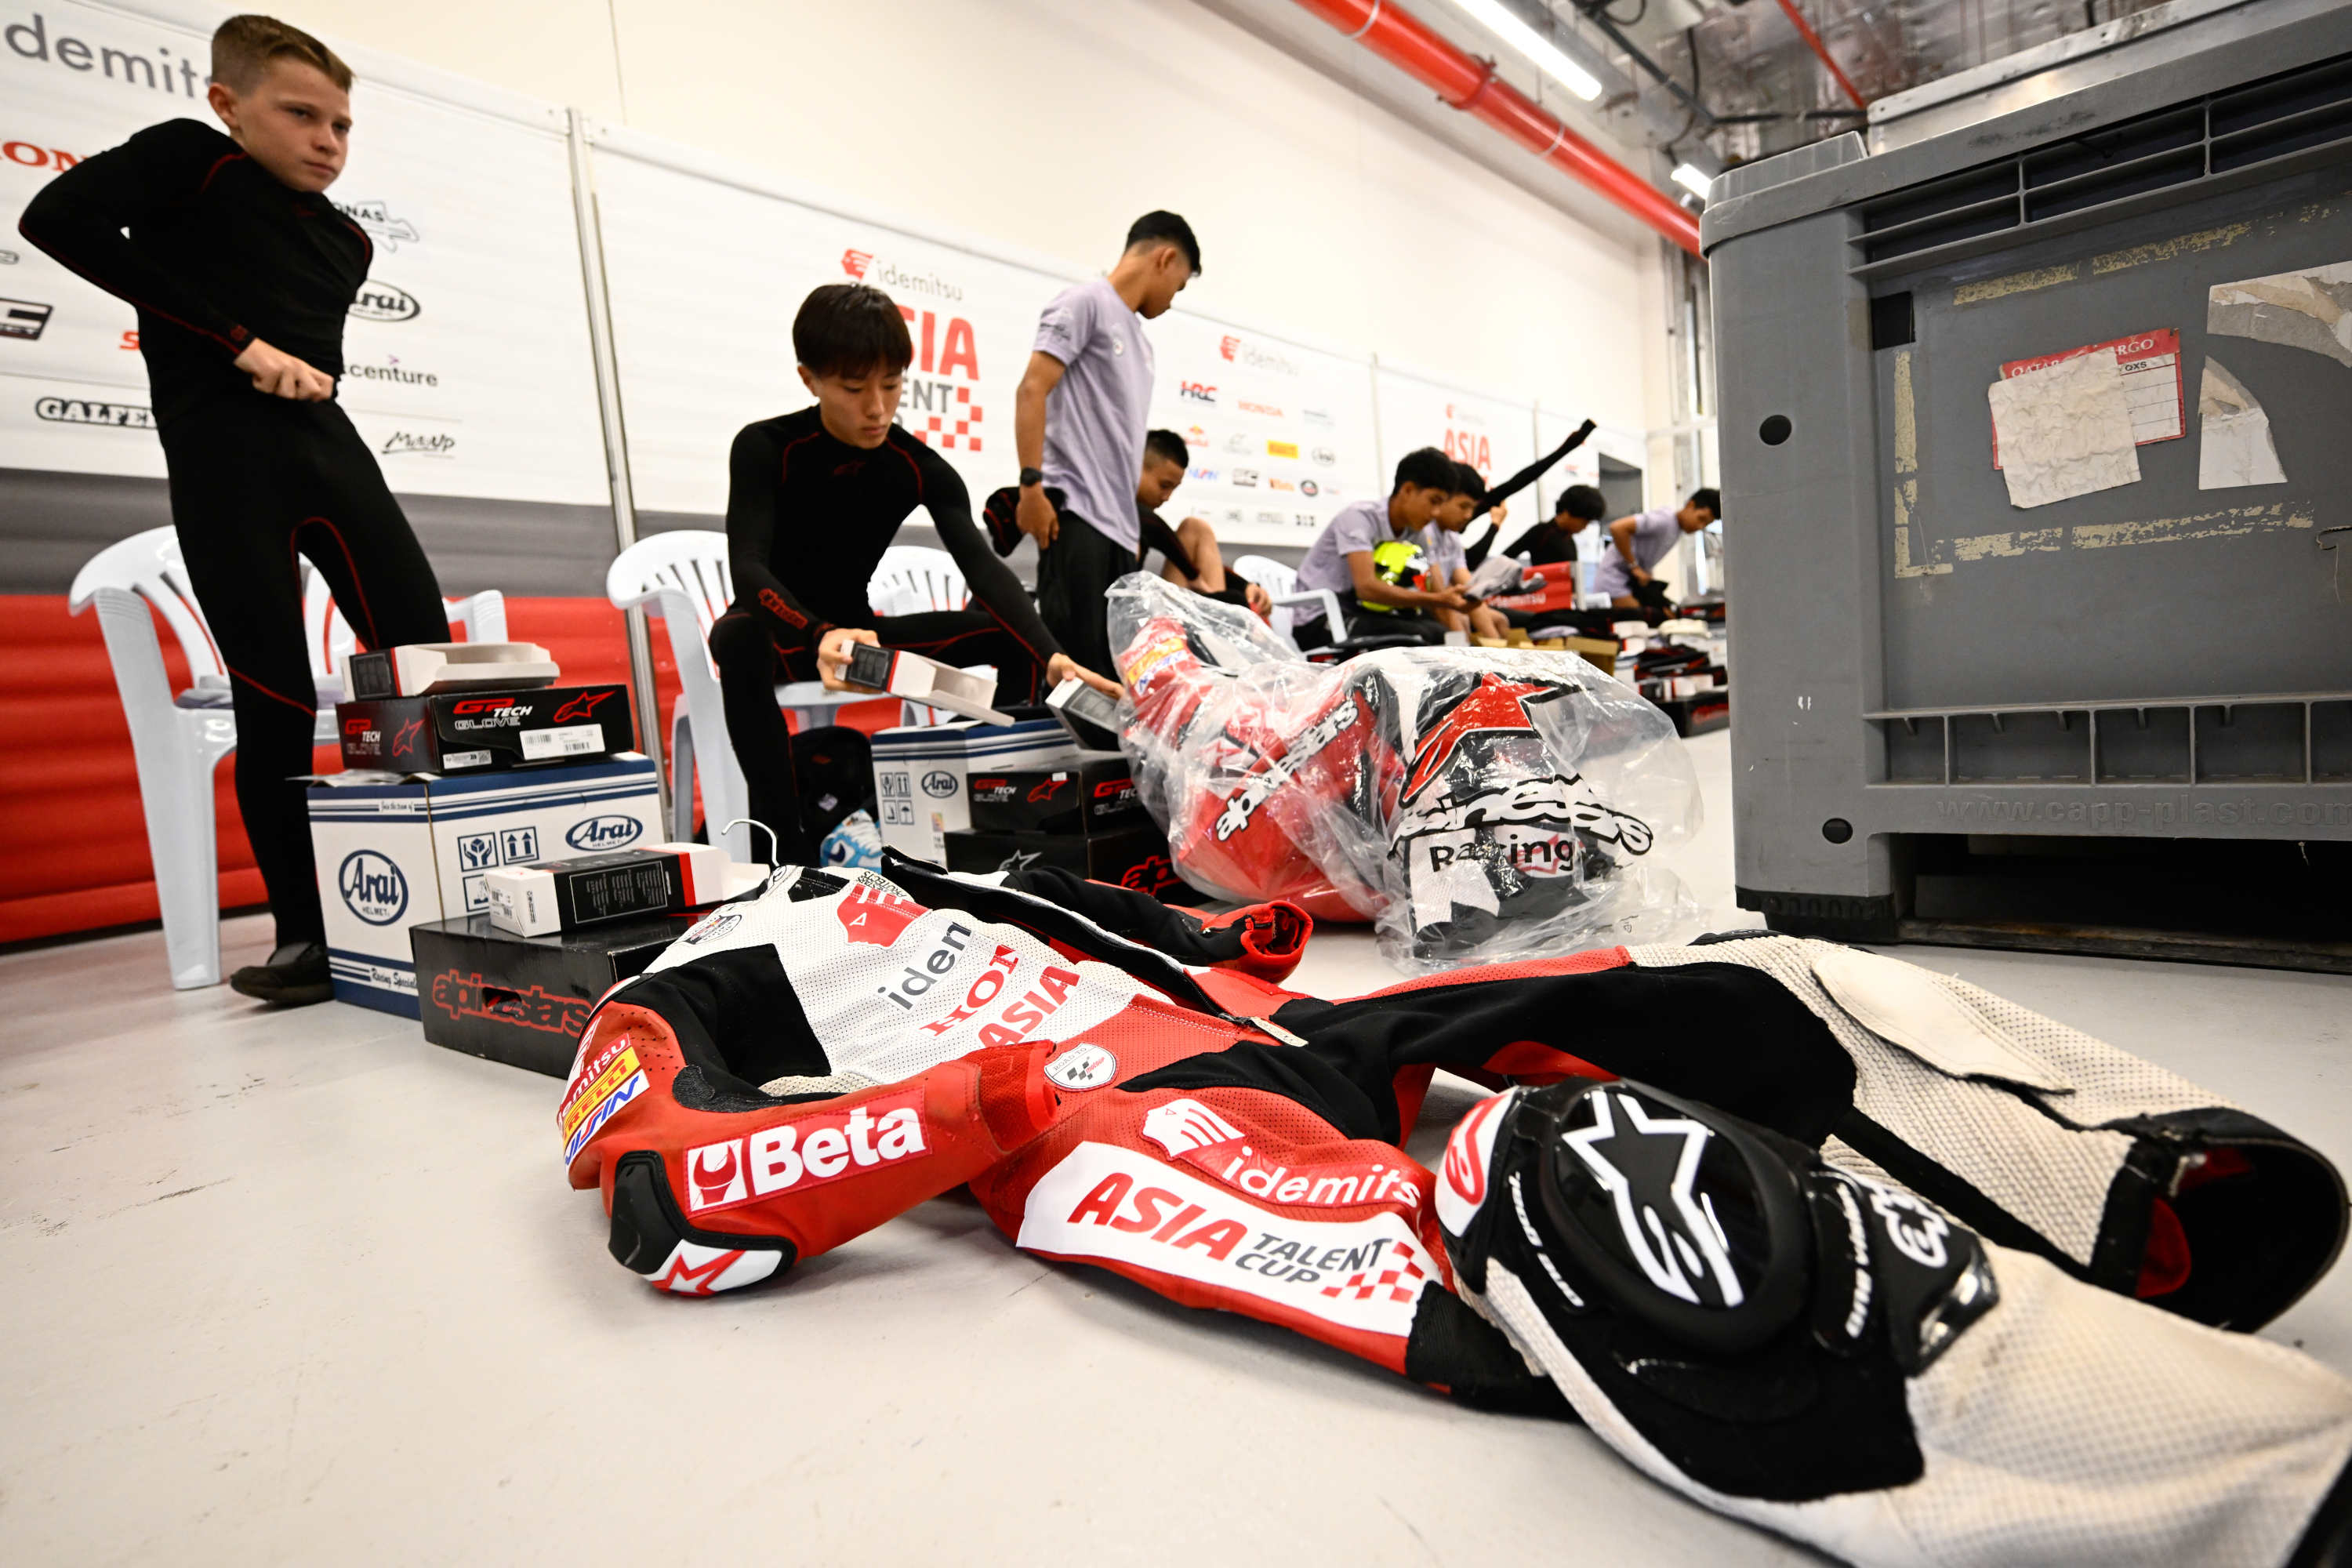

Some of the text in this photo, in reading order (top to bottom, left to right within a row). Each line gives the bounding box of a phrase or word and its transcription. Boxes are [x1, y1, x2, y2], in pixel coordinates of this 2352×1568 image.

[877, 260, 964, 301] idemitsu
[355, 292, 406, 312] rai
[2117, 338, 2154, 355] RGO
[347, 364, 438, 387] centure
[2125, 361, 2147, 372] QXS
[1180, 380, 1218, 402] HRC
[1443, 429, 1492, 471] ASIA
[453, 698, 533, 718] GP TECH
[345, 719, 382, 742] GP TECH
[455, 717, 521, 731] GLOVE
[347, 742, 382, 756] GLOVE
[925, 773, 953, 791] Arai
[993, 786, 1017, 795] TECH
[1119, 786, 1138, 800] TEC
[974, 793, 1009, 802] GLOVE
[572, 819, 633, 845] Arai
[345, 858, 399, 906] Arai
[433, 969, 594, 1038] alpistars
[978, 966, 1081, 1048] ASIA
[1053, 1054, 1075, 1071] ROAD
[750, 1106, 927, 1196] Beta
[1222, 1146, 1421, 1208] idemits
[1066, 1172, 1248, 1261] ASIA
[1252, 1232, 1392, 1272] TALENT
[1235, 1253, 1320, 1283] CUP
